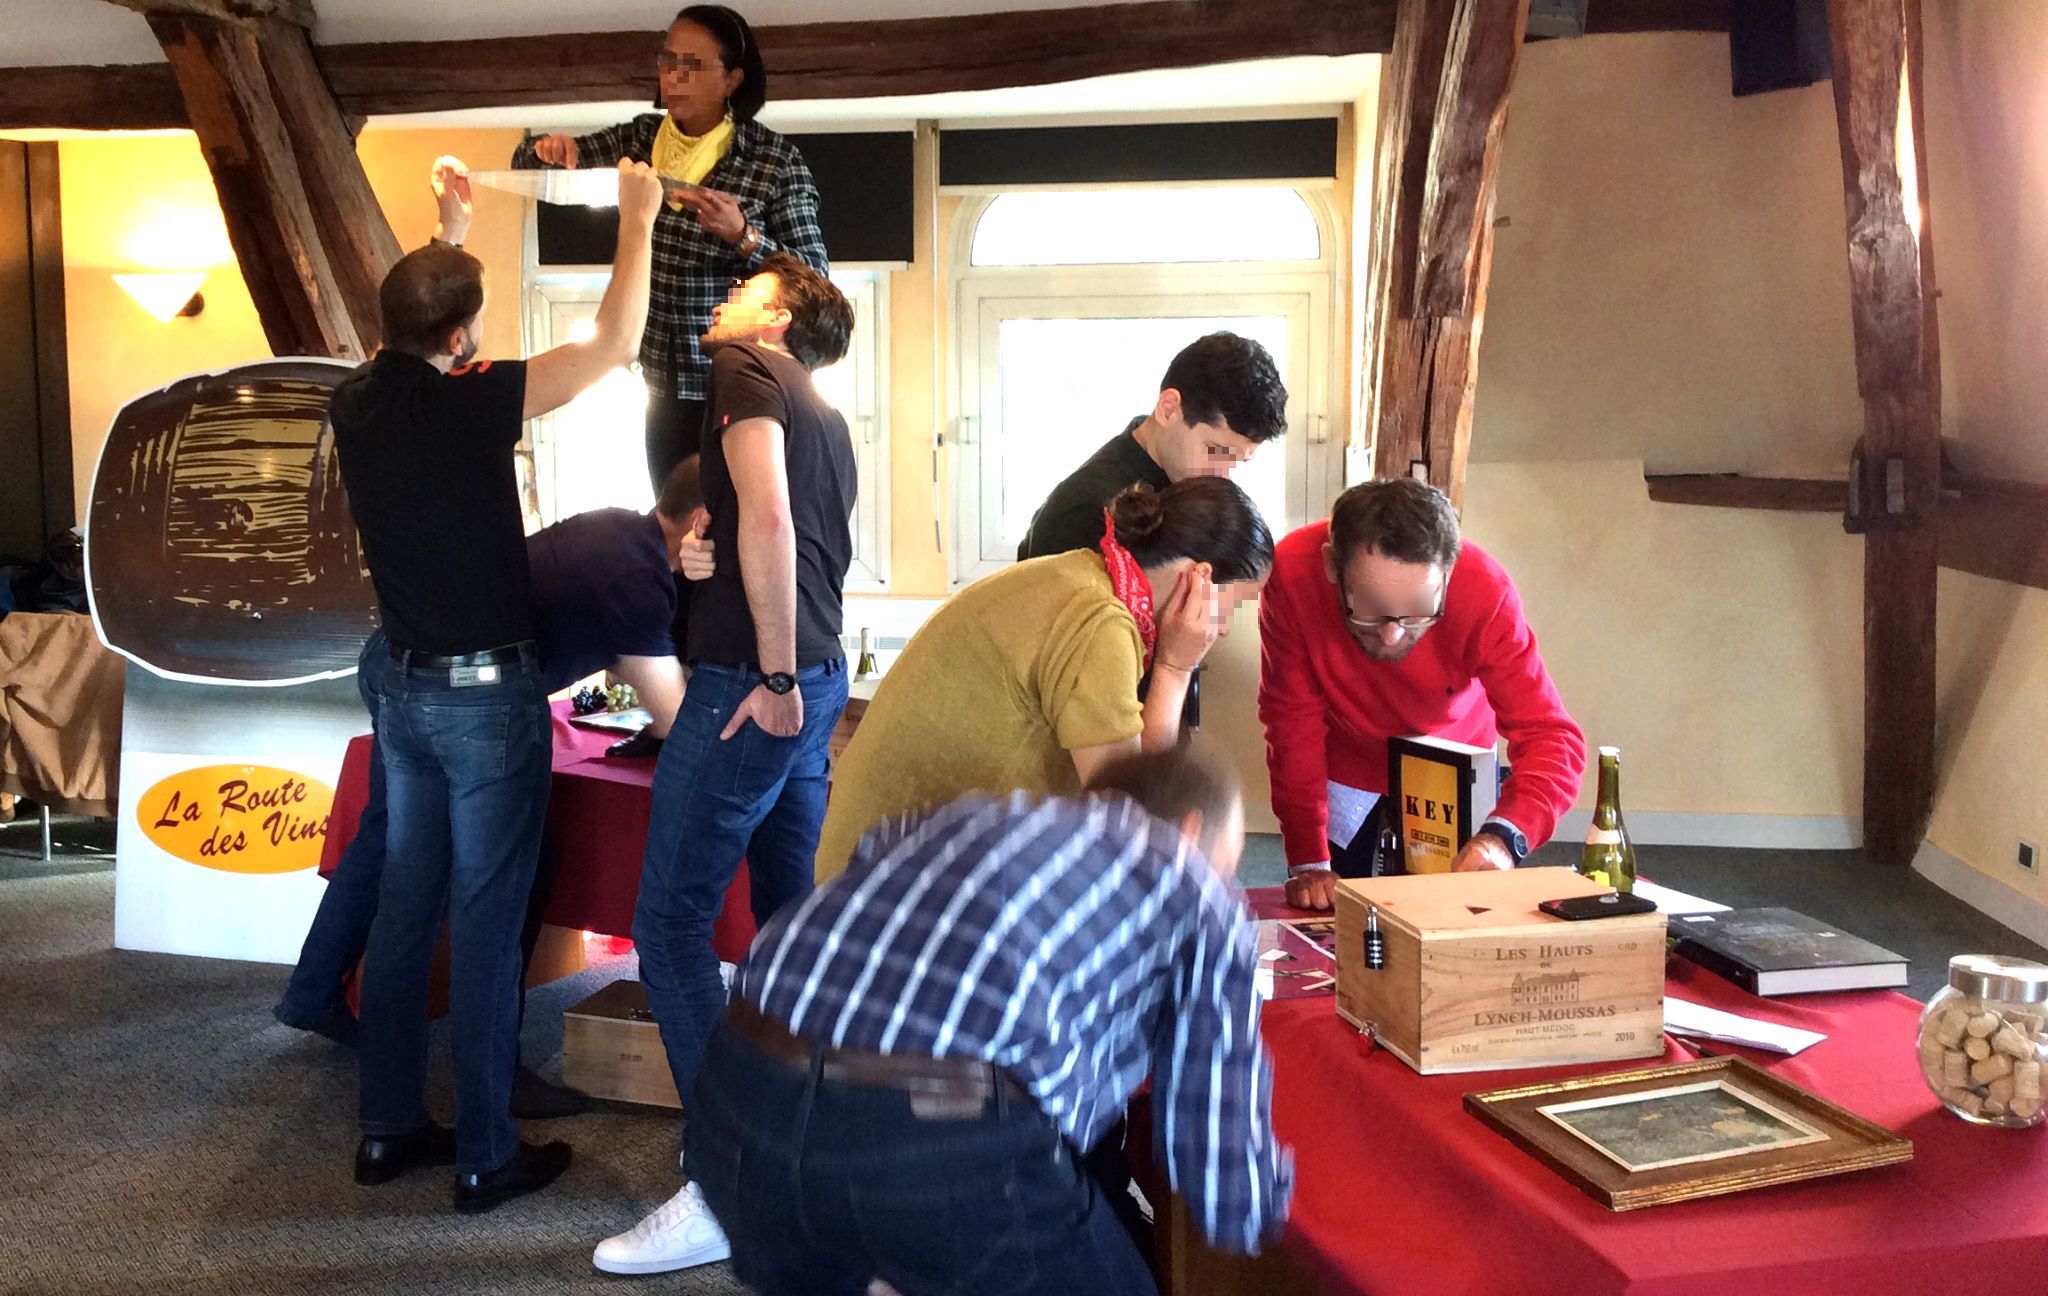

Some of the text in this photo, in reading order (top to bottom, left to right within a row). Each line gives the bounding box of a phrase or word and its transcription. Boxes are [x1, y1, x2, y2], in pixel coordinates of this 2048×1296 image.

[154, 778, 307, 829] La Route
[1405, 795, 1454, 825] KEY
[200, 811, 329, 857] des Vins
[1495, 944, 1594, 961] LES HAUTS
[1473, 1005, 1617, 1027] LYNCH-MOUSSAS
[1615, 1032, 1636, 1043] 2010
